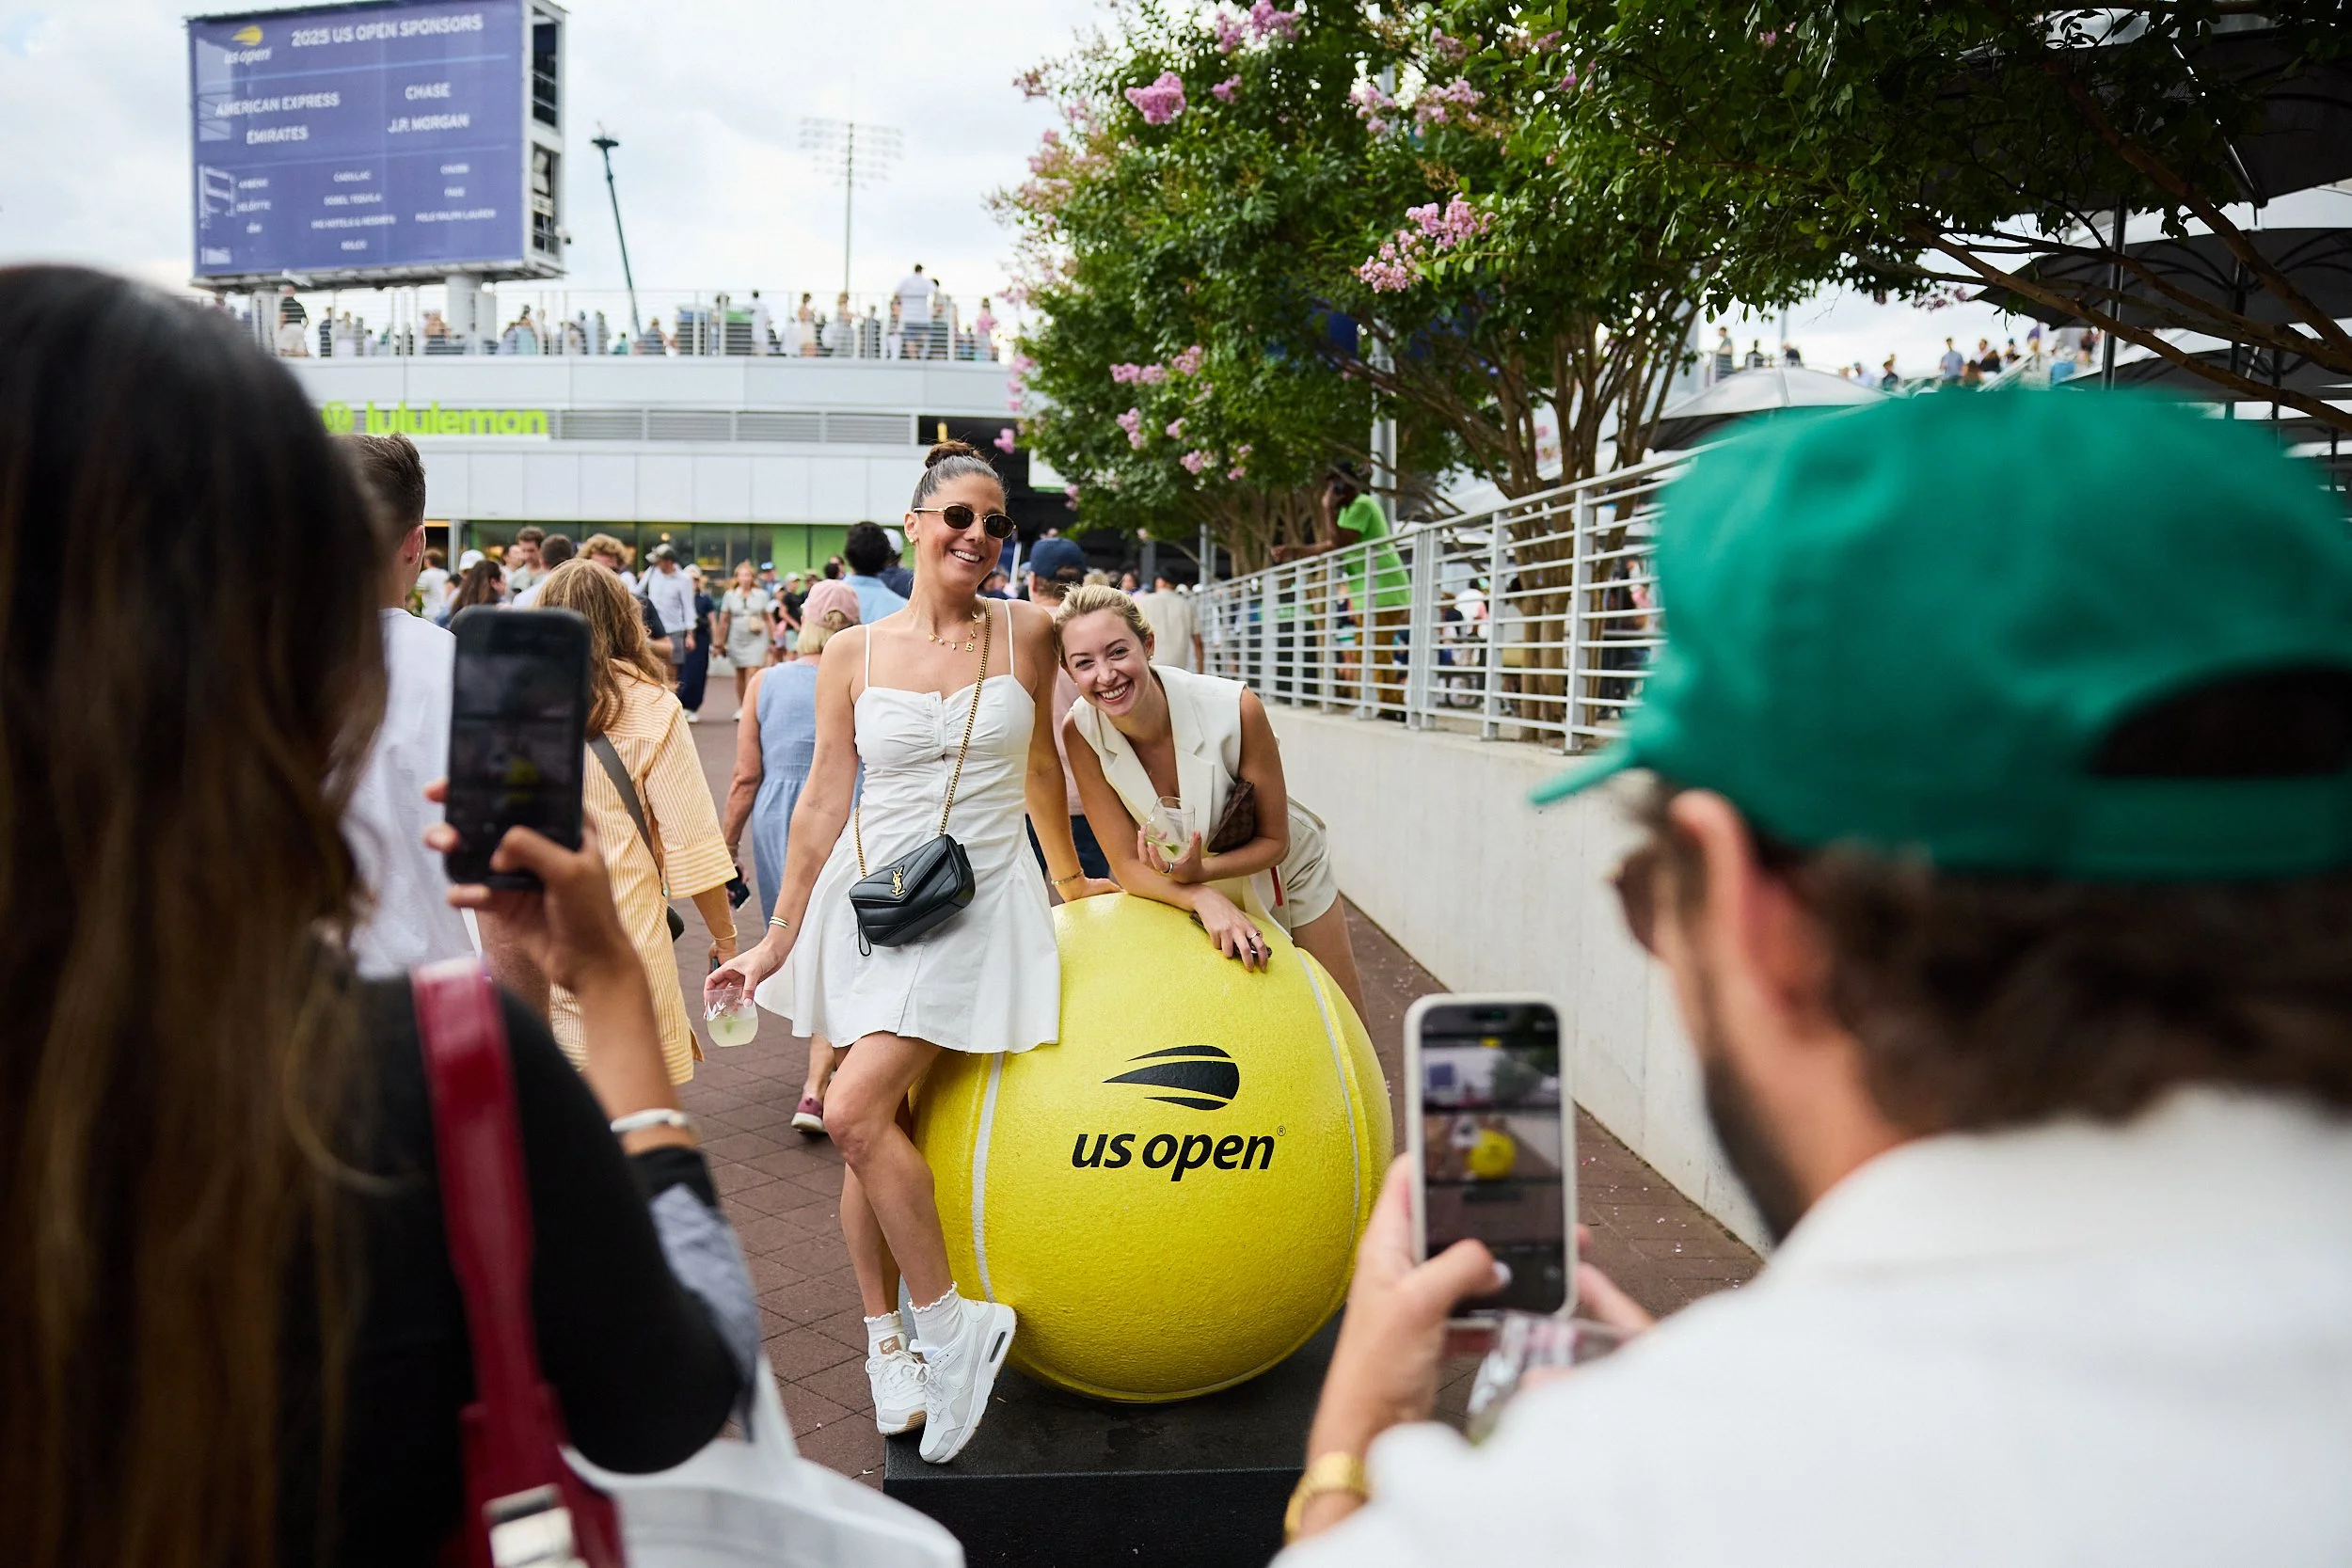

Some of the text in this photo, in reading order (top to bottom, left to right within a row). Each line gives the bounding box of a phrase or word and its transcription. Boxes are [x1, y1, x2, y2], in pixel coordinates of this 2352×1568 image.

[291, 13, 484, 47] 2025 US OPEN SPONSORS
[224, 47, 272, 66] us open
[405, 82, 451, 101] CHASE
[215, 91, 341, 118] AMERICAN EXPRESS
[411, 113, 470, 131] MORGAN
[246, 124, 309, 145] EMIRATES
[365, 401, 548, 435] lululemon
[1072, 1133, 1136, 1168] us
[1142, 1133, 1275, 1181] open
